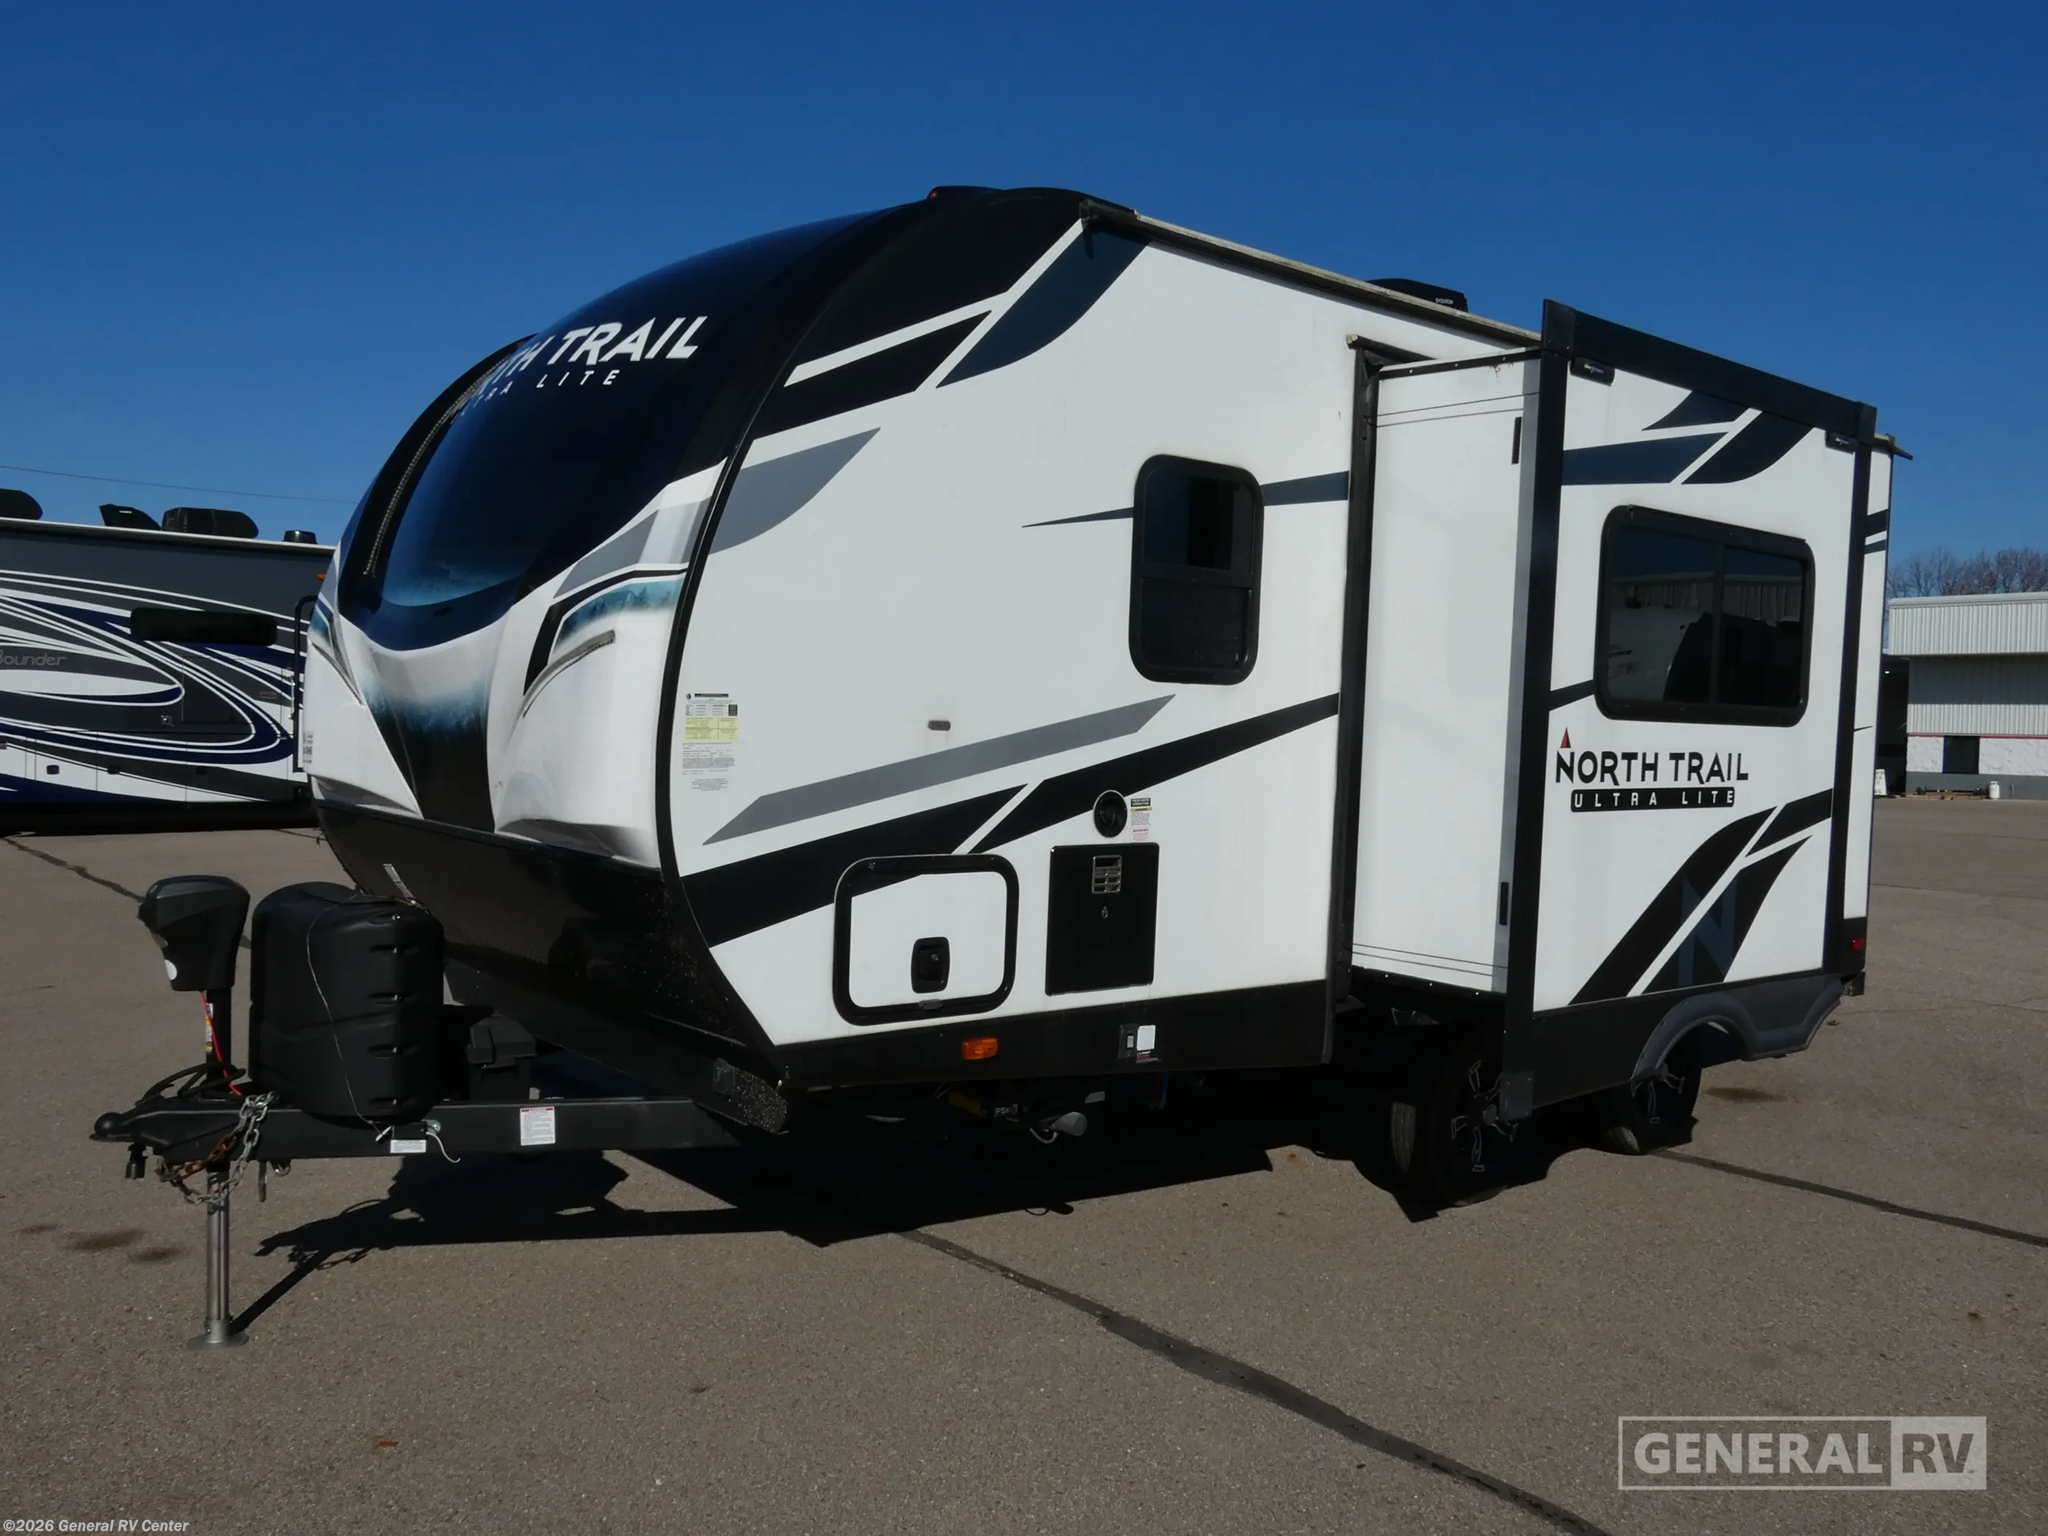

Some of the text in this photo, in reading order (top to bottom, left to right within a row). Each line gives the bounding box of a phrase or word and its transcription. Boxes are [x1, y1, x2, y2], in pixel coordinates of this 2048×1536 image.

[546, 316, 708, 366] TRAIL
[536, 369, 620, 389] LITE
[1555, 750, 1749, 786] NORTH TRAIL
[1574, 790, 1734, 808] ULTRA LITE
